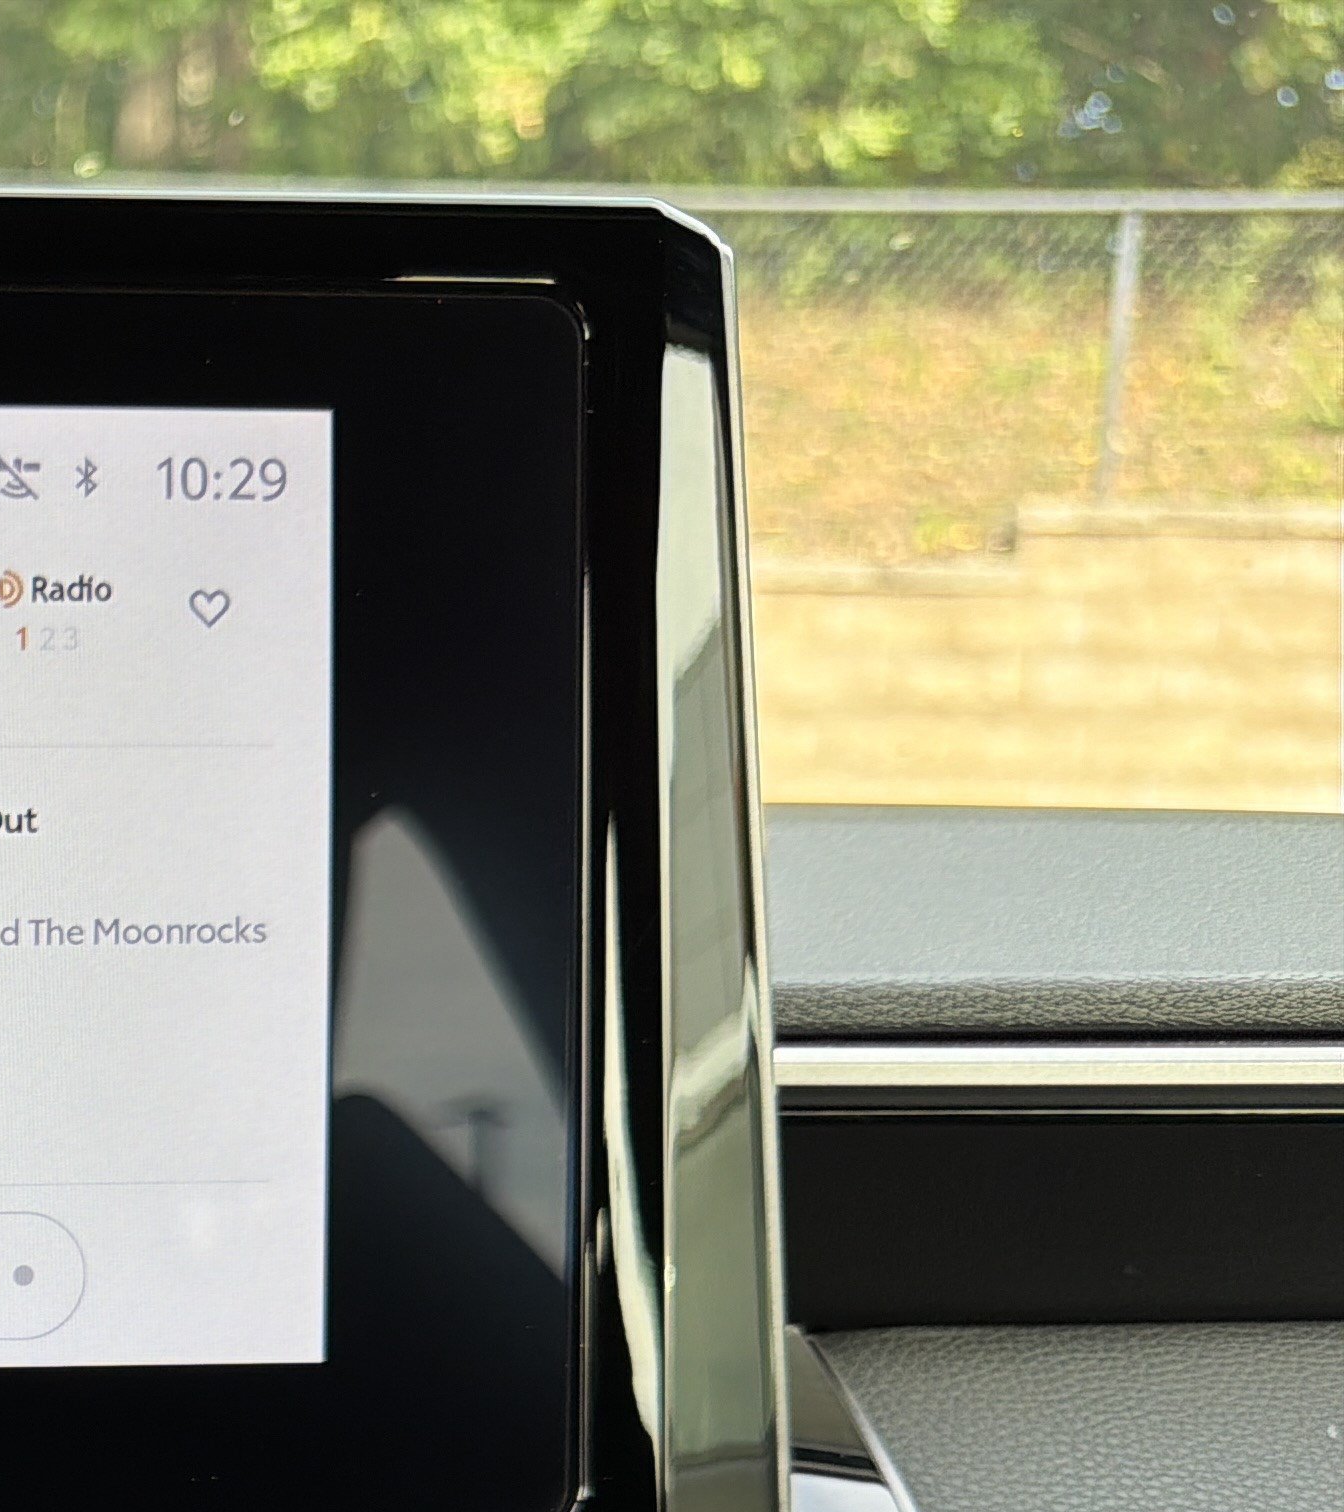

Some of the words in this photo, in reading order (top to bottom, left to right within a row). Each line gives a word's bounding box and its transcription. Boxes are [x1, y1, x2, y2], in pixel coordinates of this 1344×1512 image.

[157, 457, 288, 502] 10:29
[31, 574, 112, 603] Radio
[16, 626, 28, 651] 1
[40, 627, 55, 651] 2
[28, 918, 85, 946] The
[93, 916, 268, 945] Moonrocks
